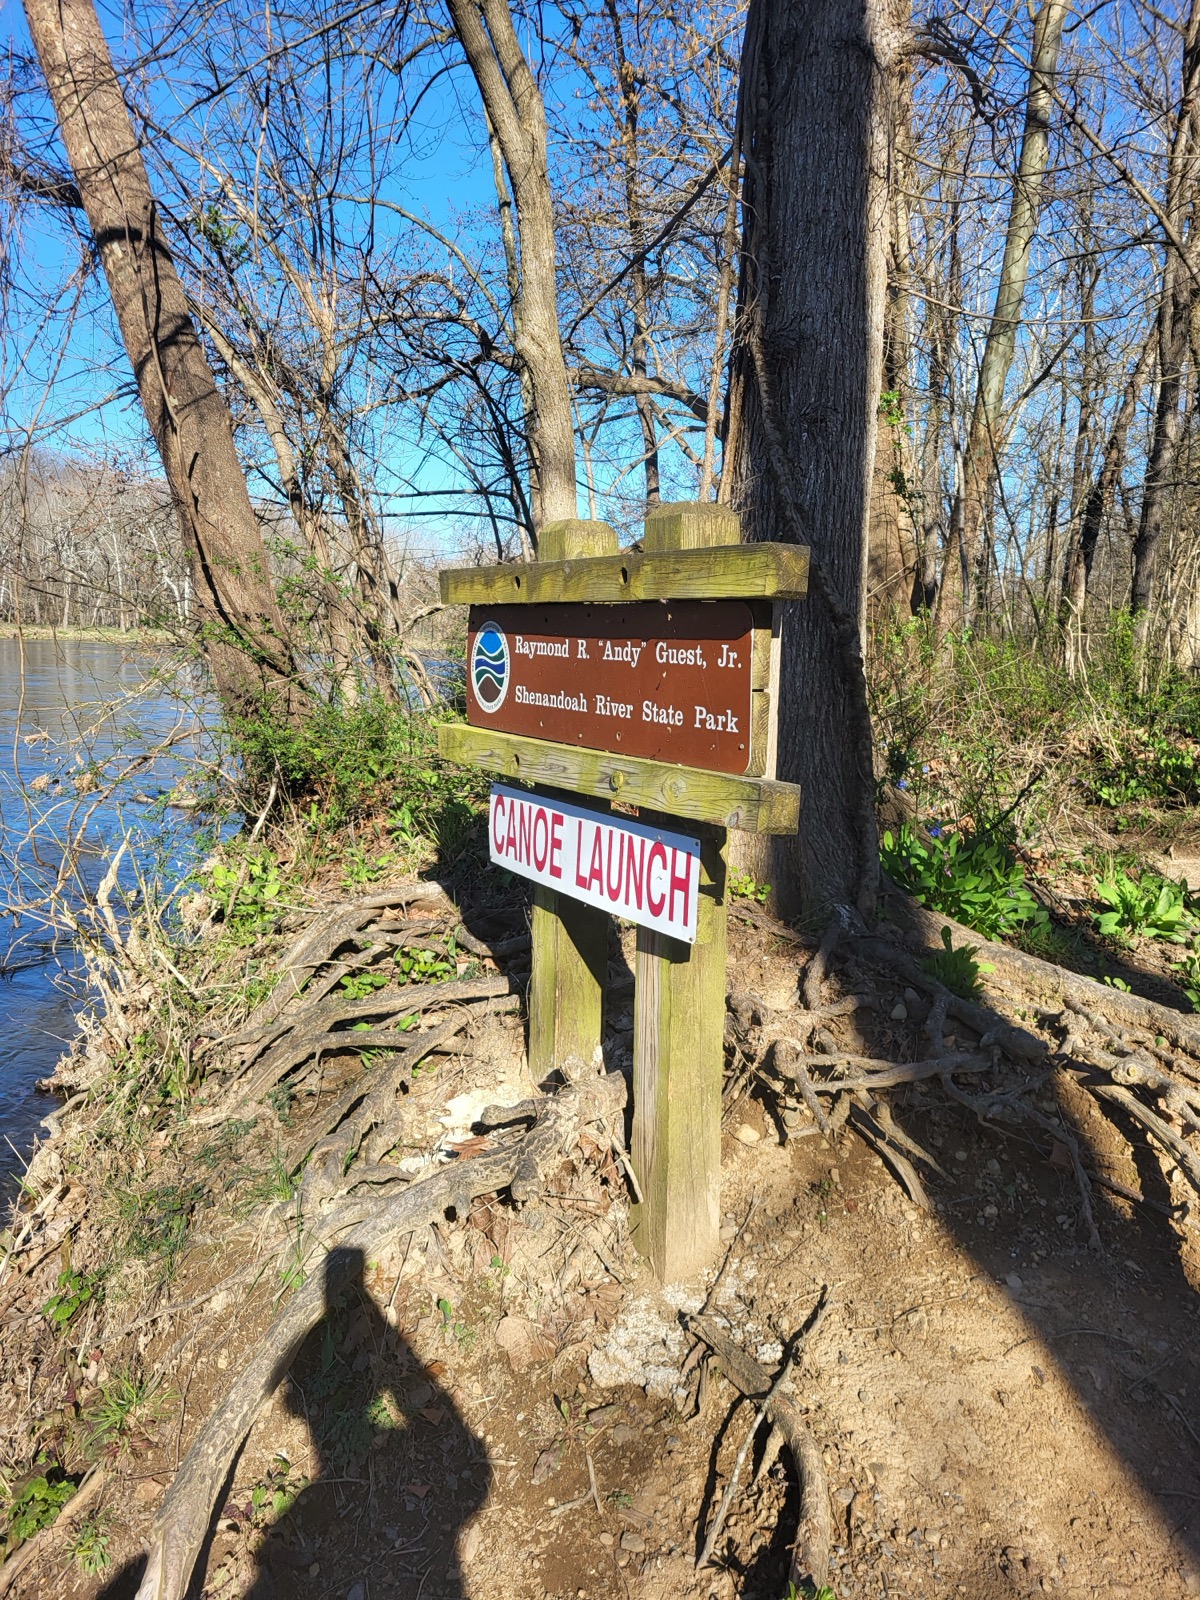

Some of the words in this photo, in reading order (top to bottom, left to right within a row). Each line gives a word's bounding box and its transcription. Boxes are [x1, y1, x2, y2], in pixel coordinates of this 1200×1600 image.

[515, 636, 569, 659] Raymond
[577, 640, 590, 659] R.
[655, 642, 707, 669] Guest,
[717, 644, 742, 669] Jr.
[515, 686, 588, 712] Shenandoah
[595, 694, 633, 719] River
[642, 700, 684, 726] State
[694, 706, 739, 733] Park
[493, 793, 564, 879] CANOE
[575, 820, 692, 927] LAUNCH
